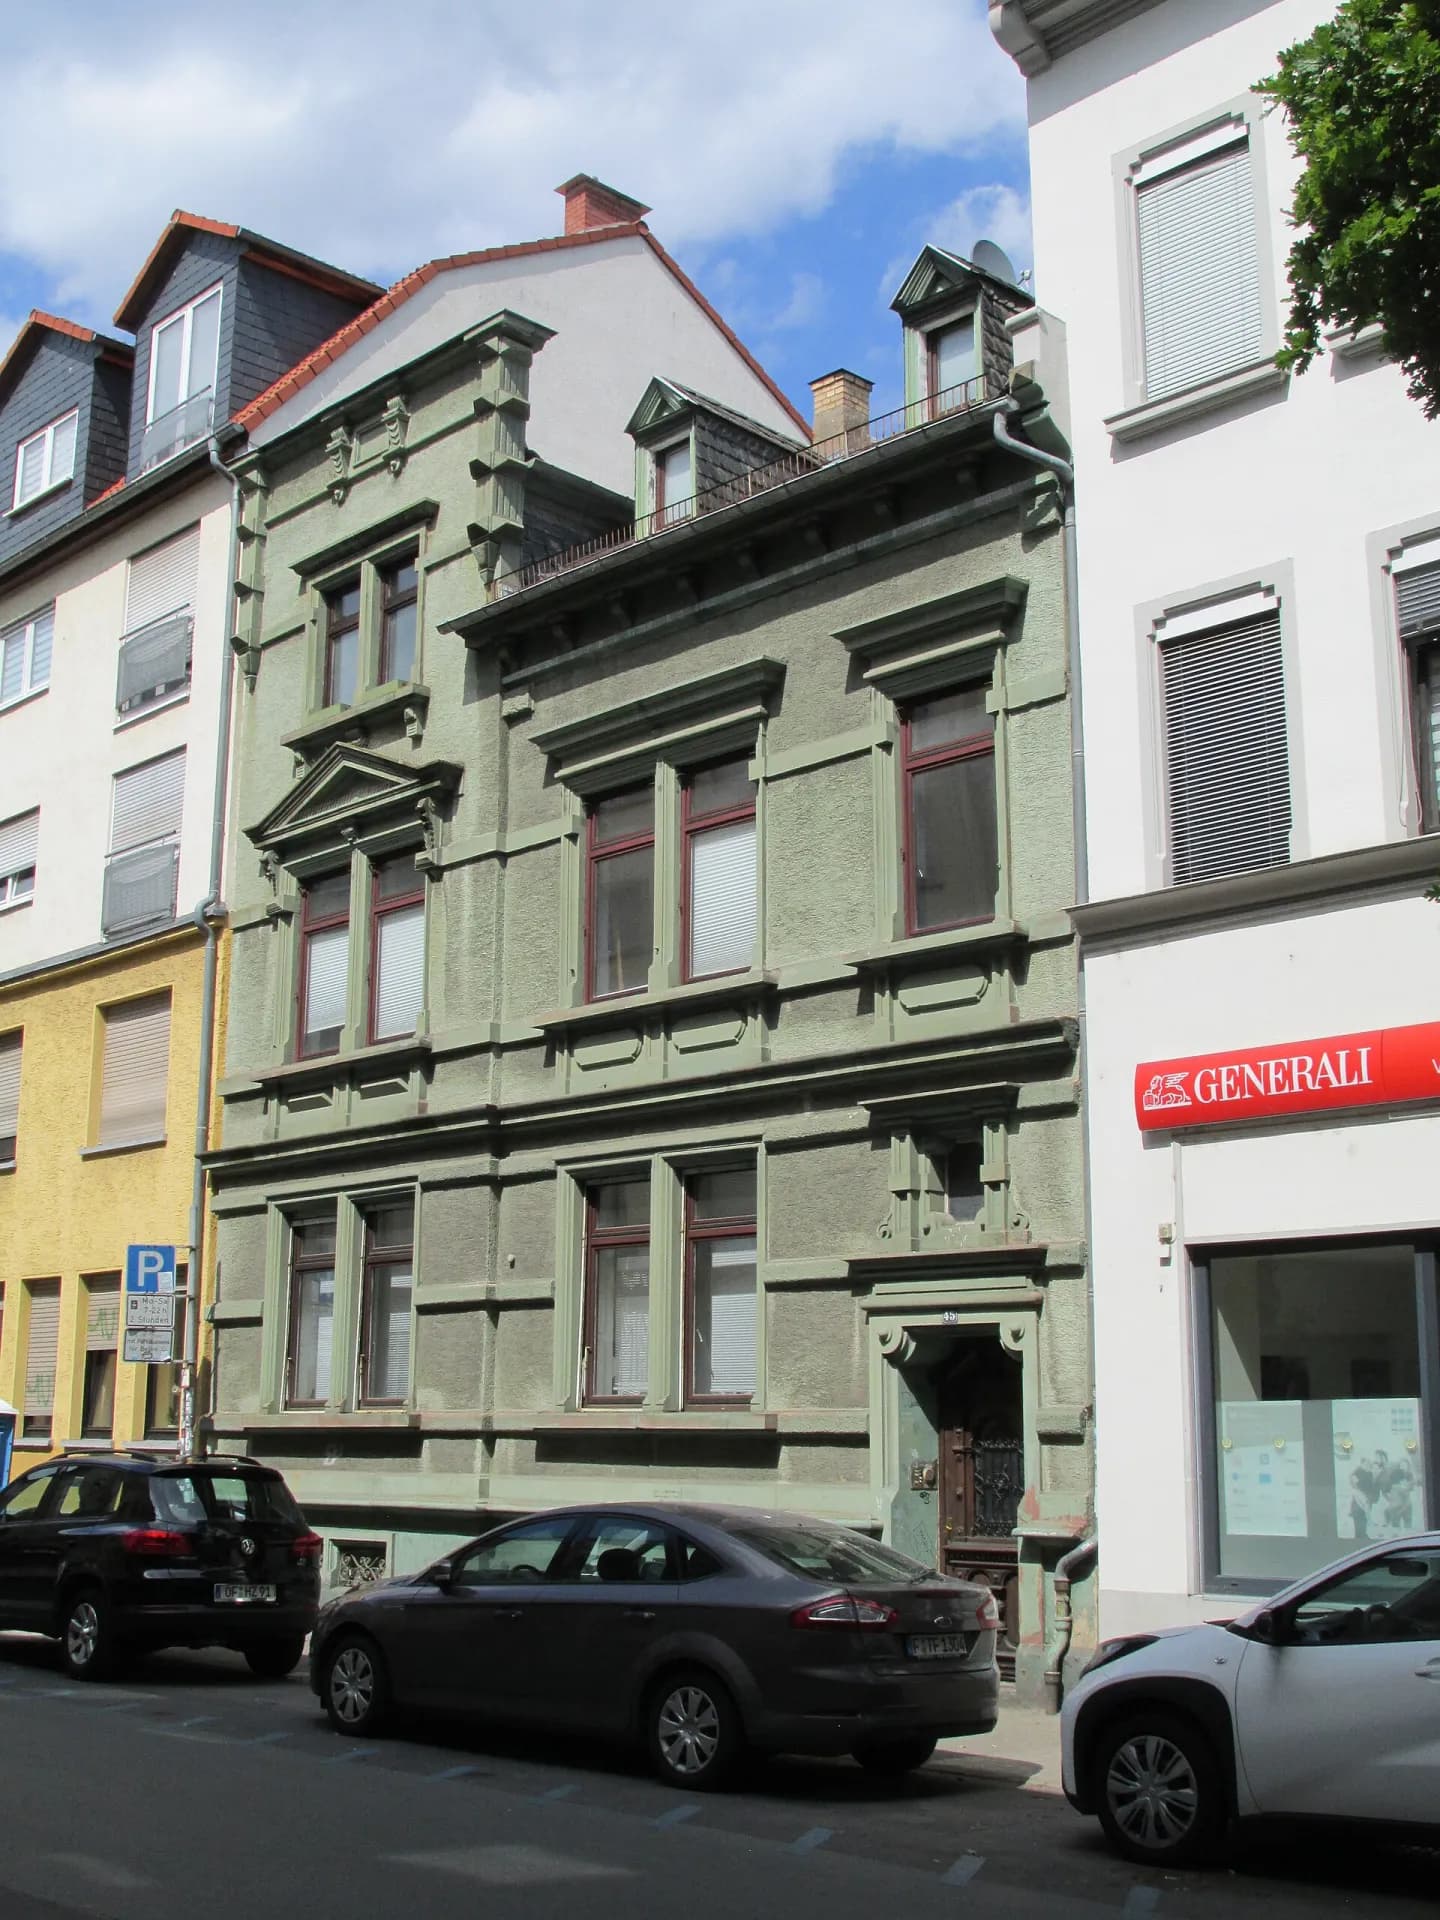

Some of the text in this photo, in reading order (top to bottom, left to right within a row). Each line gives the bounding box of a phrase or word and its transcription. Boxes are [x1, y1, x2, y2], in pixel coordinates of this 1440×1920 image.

[1194, 1047, 1373, 1104] GENERALI
[138, 1251, 164, 1287] P
[138, 1315, 169, 1324] Stunden
